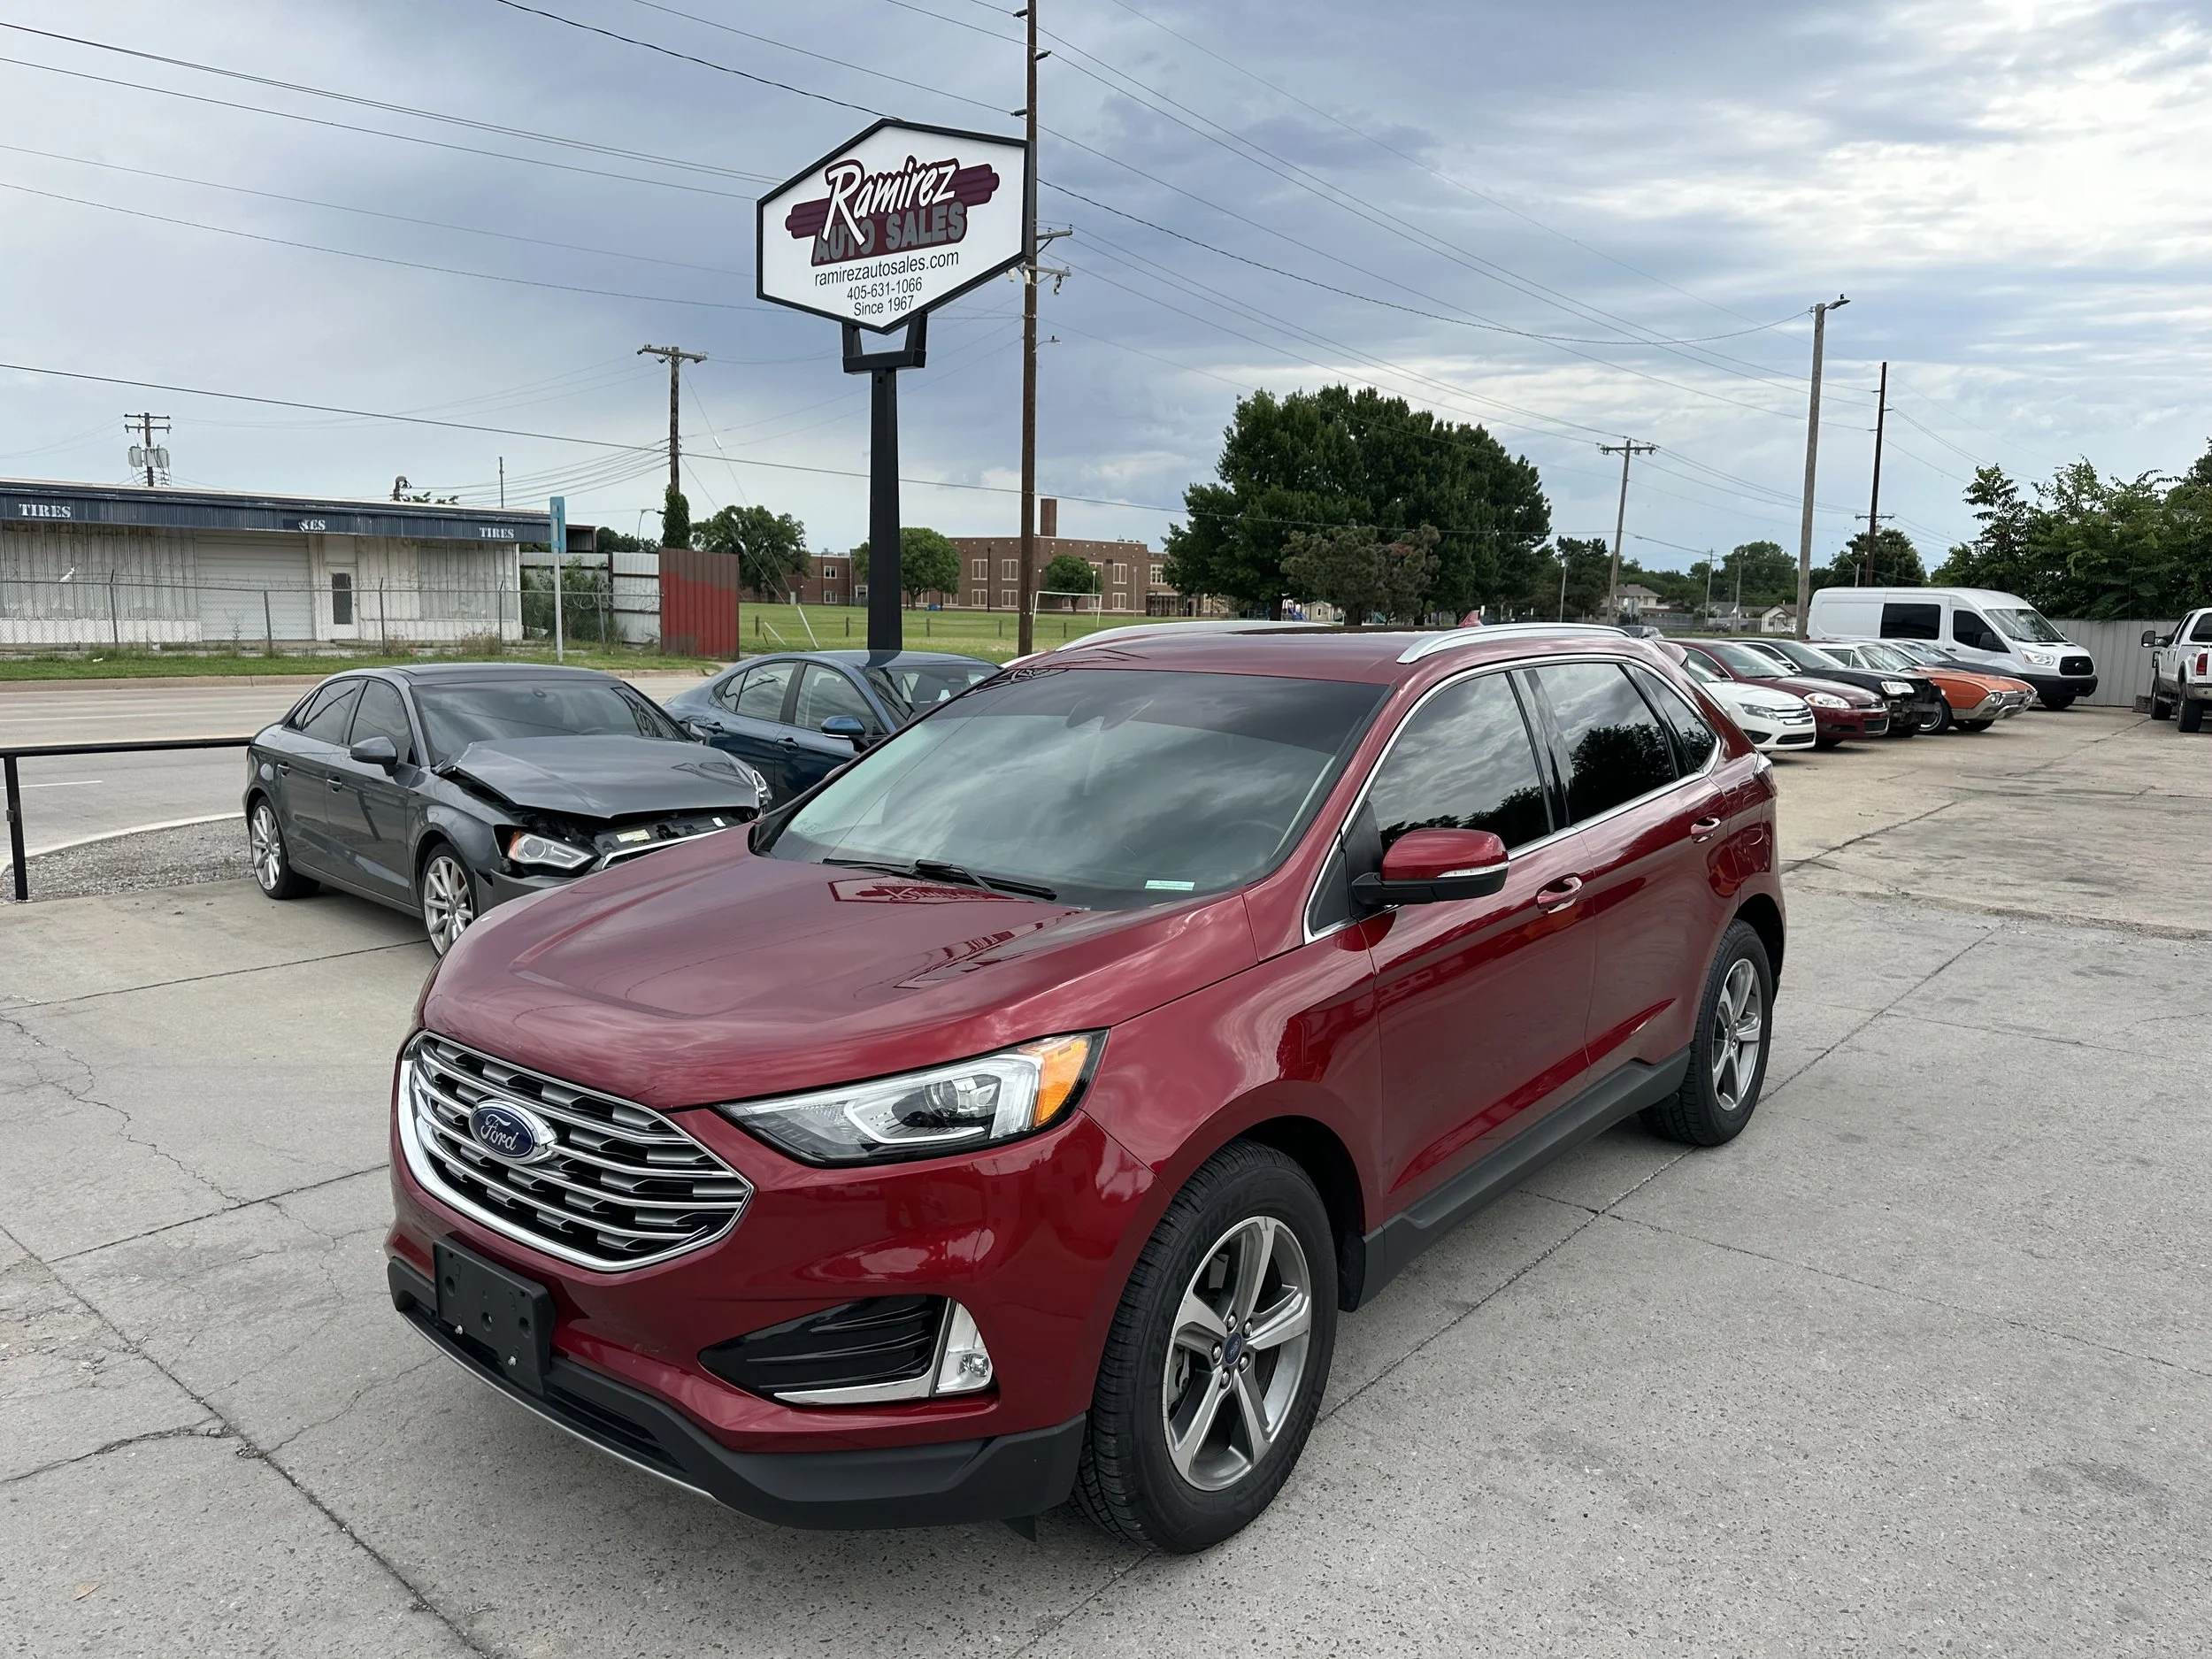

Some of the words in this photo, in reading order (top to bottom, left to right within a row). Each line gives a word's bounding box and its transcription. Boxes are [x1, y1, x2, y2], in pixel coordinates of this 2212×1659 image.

[822, 161, 956, 246] Ramirez
[814, 219, 876, 263] AUTO
[886, 202, 965, 250] SALES
[815, 251, 959, 287] ramirezautosales.com
[847, 277, 922, 301] 405-631-1066
[854, 302, 884, 317] Since
[887, 296, 914, 312] 1967
[19, 503, 71, 518] TIRES
[479, 527, 514, 539] TIRES
[480, 1114, 519, 1150] Ford
